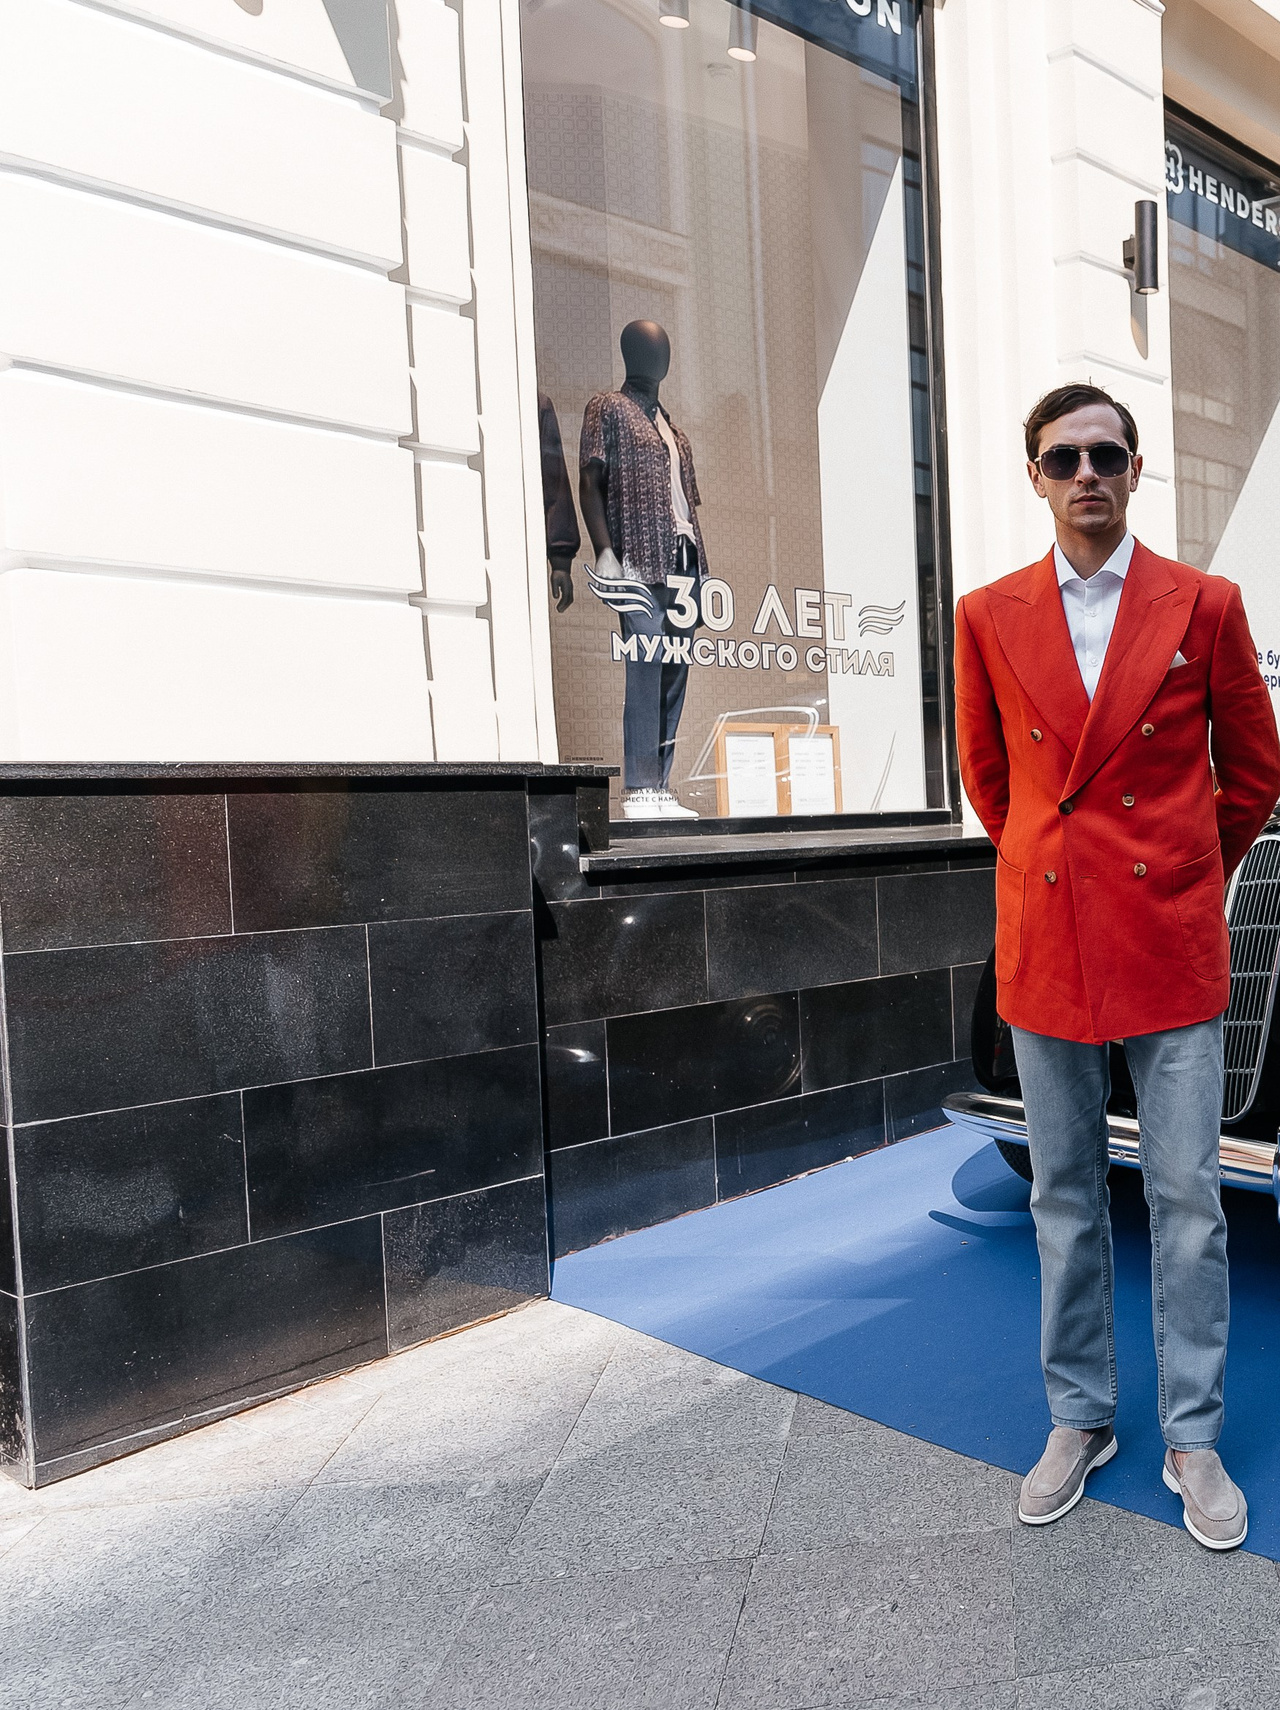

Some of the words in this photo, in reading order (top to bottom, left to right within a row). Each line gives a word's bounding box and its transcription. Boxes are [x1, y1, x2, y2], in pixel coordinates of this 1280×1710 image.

[665, 573, 735, 633] 30
[752, 584, 853, 642] ЛЕТ
[611, 631, 799, 672] МУЖСКОГО
[804, 645, 896, 678] СТИЛЯ
